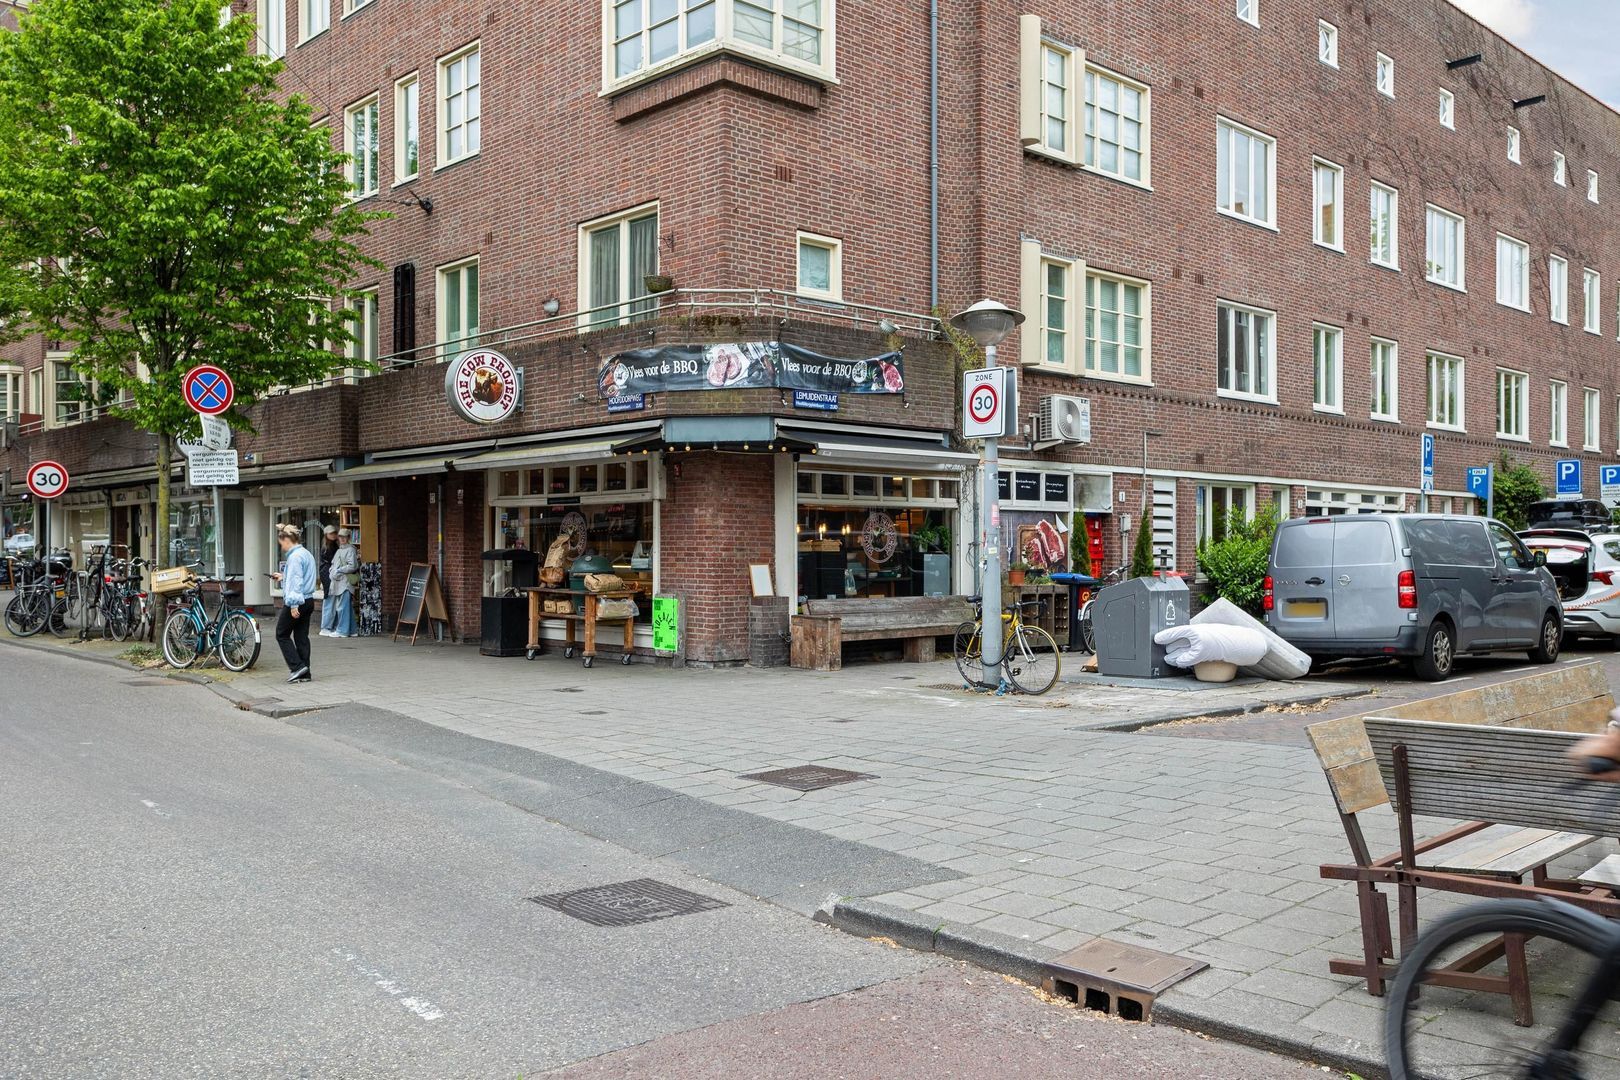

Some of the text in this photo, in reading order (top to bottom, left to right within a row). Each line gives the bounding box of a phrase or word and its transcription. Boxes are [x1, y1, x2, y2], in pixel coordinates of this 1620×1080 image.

[628, 359, 699, 379] Vlees voor de BBQ
[781, 357, 853, 379] Vlees voor de BBQ
[460, 355, 514, 411] THE COW PROJECT
[975, 373, 993, 382] ZONE
[795, 391, 838, 403] LEIMUIDENSTRAAT
[974, 395, 993, 411] 30
[1425, 438, 1432, 459] P
[36, 472, 61, 486] 30
[1561, 463, 1575, 480] P
[1606, 468, 1618, 484] P
[1473, 476, 1482, 489] P
